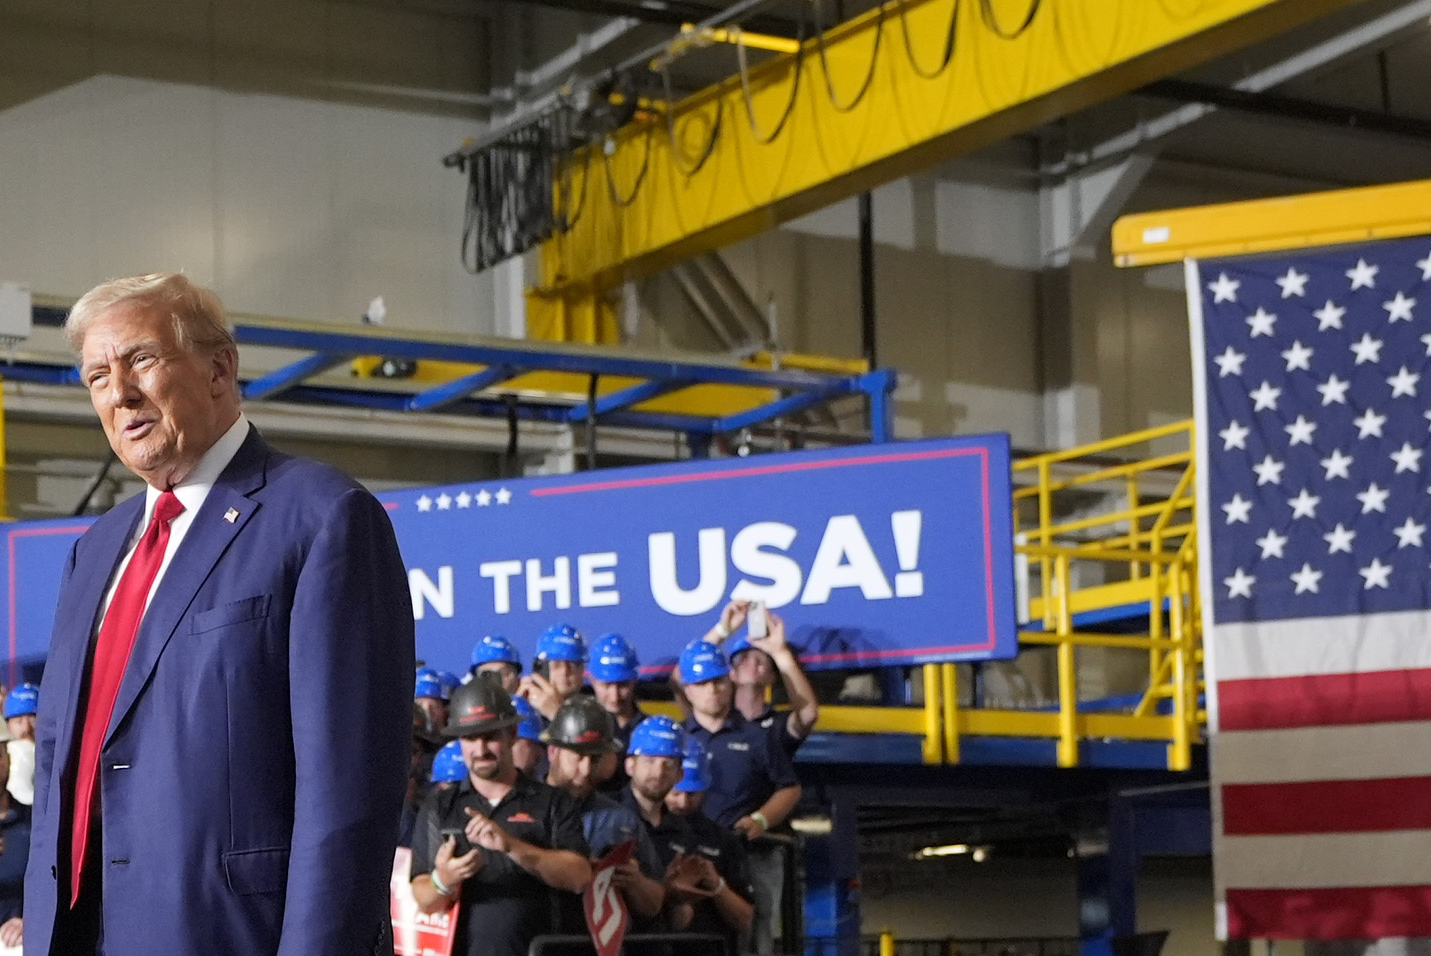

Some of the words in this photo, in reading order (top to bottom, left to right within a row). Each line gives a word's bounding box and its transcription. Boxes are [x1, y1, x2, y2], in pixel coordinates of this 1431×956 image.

[408, 565, 455, 621] N
[479, 551, 621, 615] THE
[647, 509, 925, 617] USA!
